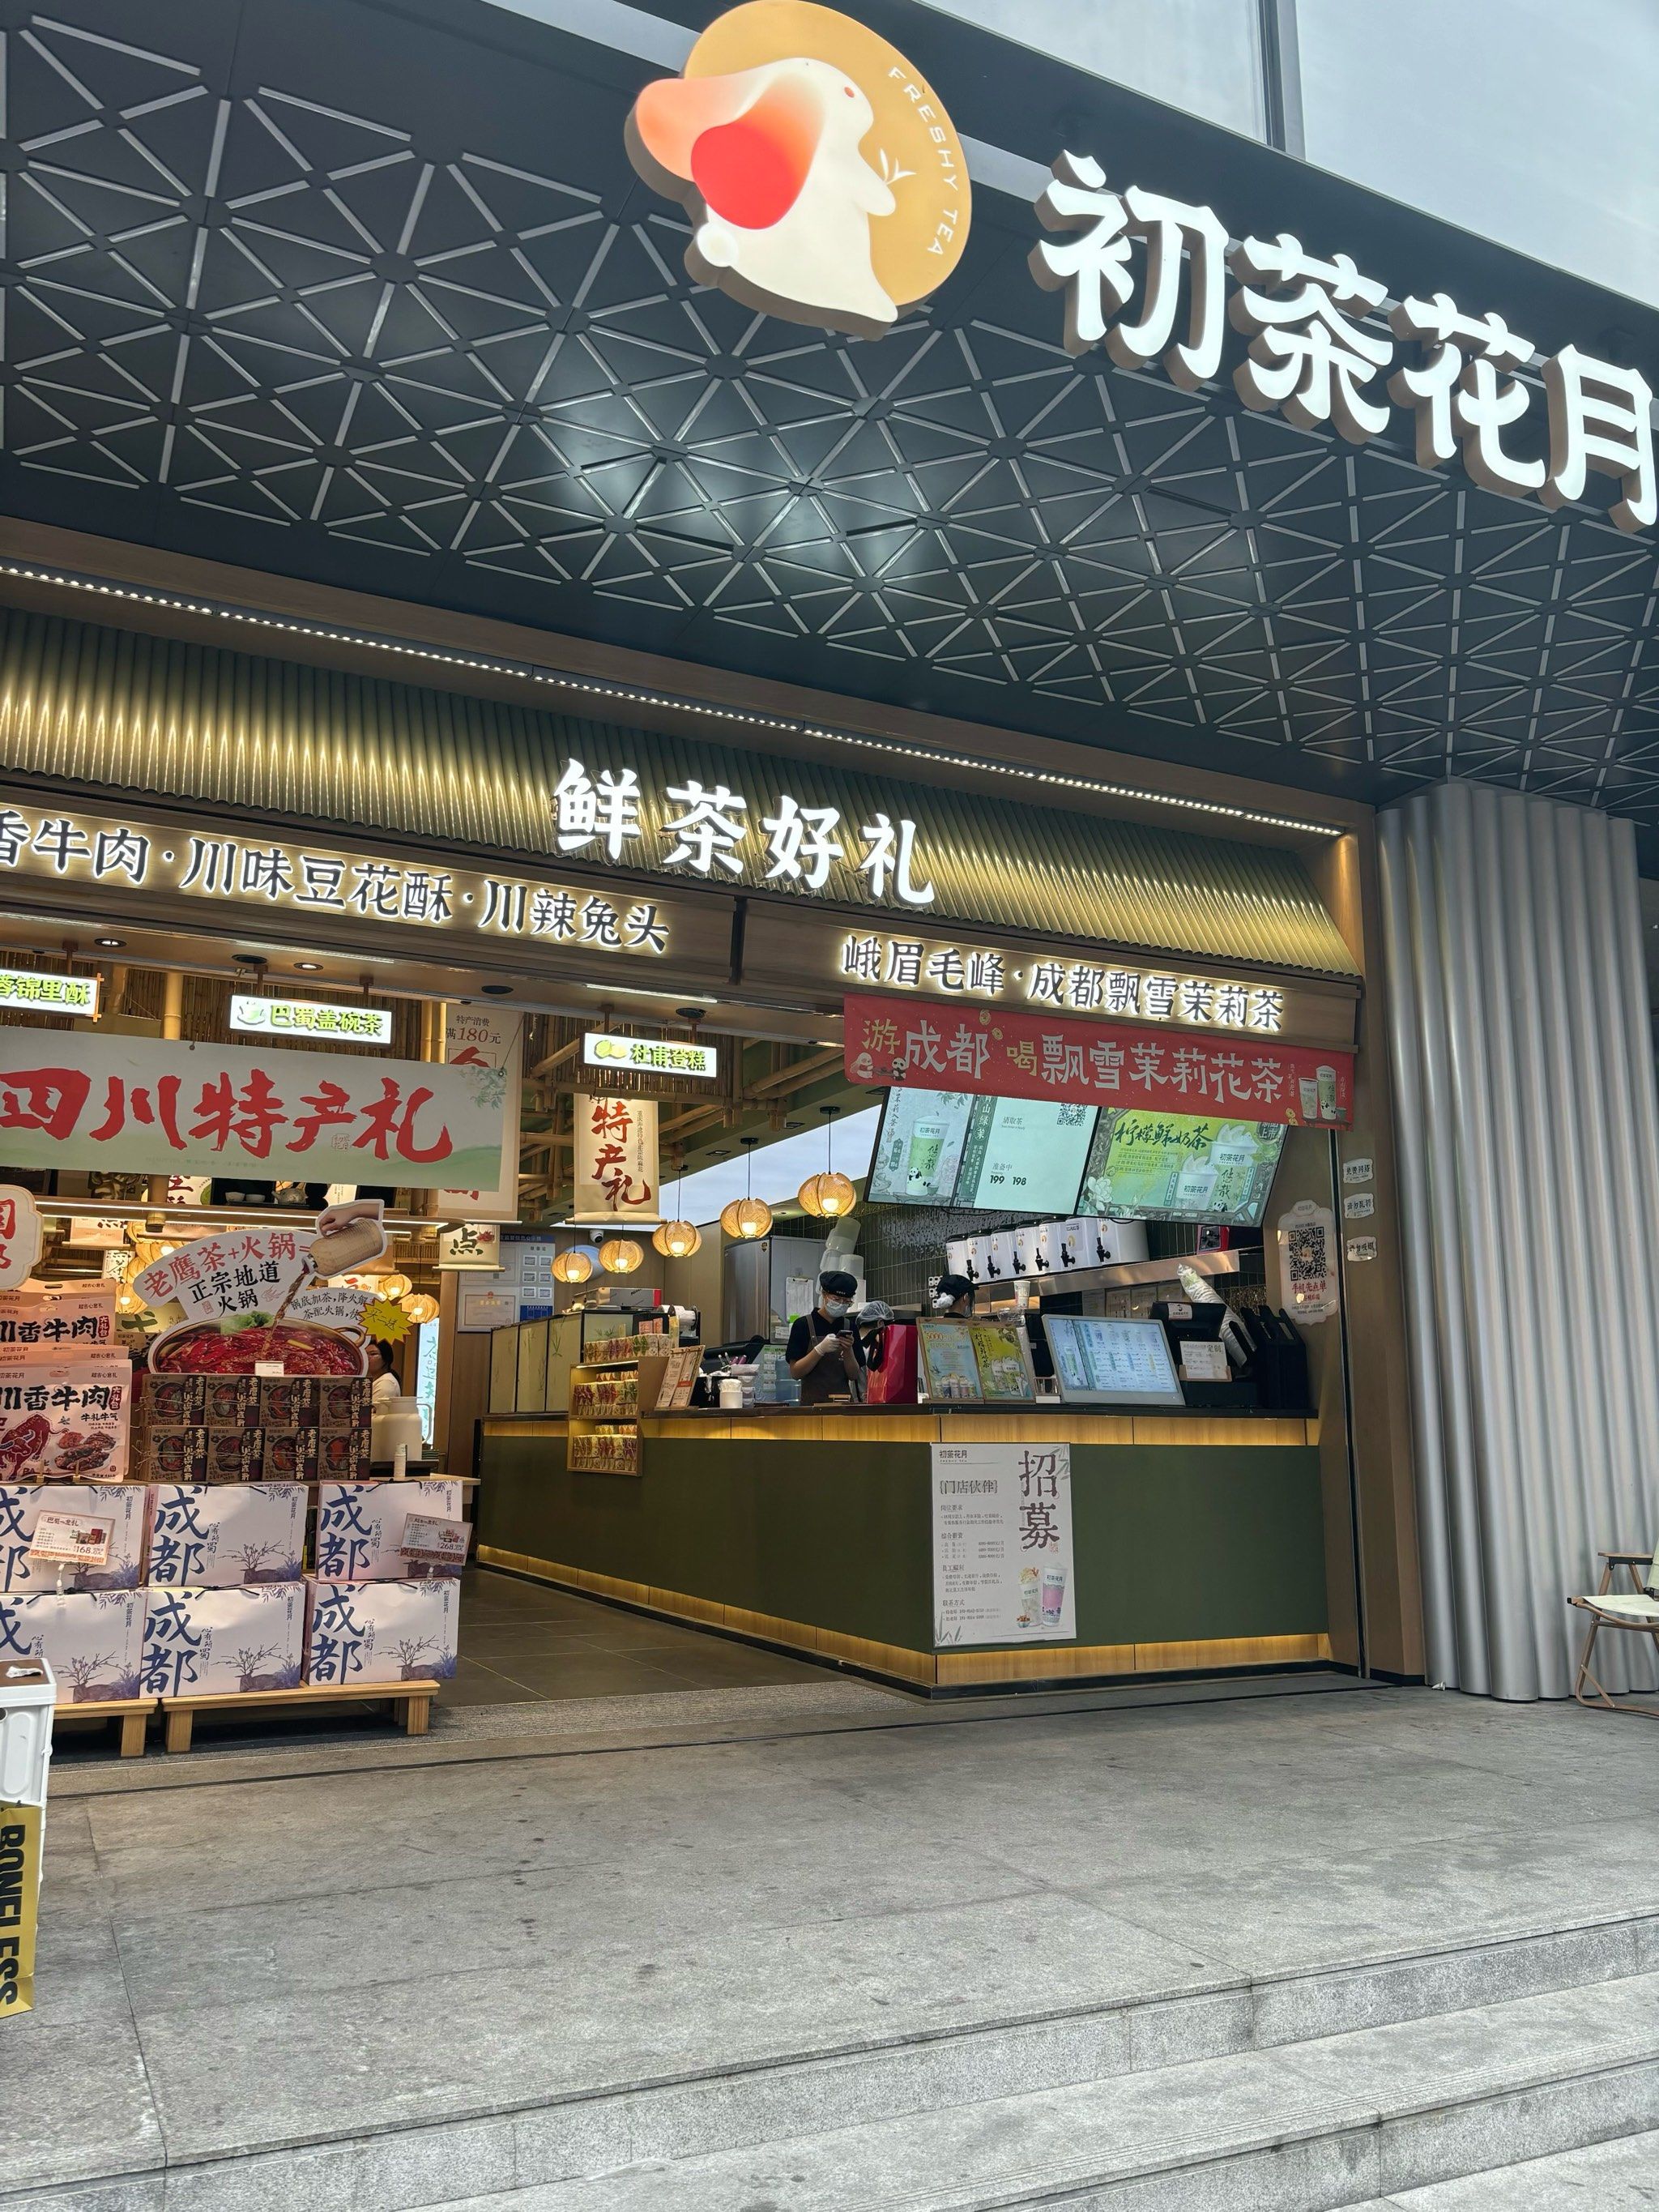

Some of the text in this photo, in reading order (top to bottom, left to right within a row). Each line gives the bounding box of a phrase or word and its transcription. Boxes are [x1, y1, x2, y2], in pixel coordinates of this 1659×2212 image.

[889, 66, 959, 256] FRESHY TEA
[1030, 149, 1659, 528] 初茶花月
[553, 758, 936, 904] 鲜茶好礼
[270, 1003, 383, 1037] 巴蜀盖碗茶
[446, 1027, 501, 1044] 满180元
[456, 1014, 490, 1027] 特产消费
[0, 1067, 454, 1164] 四川特产礼
[1114, 1118, 1215, 1150] 柠檬鲜奶茶
[591, 1100, 652, 1211] 特产礼
[1219, 1153, 1246, 1162] 初茶花月
[990, 1175, 1027, 1185] 199 198
[1183, 1185, 1208, 1194] 初茶花月
[188, 1260, 281, 1305] 正宗地道
[218, 1288, 259, 1317] 火锅
[0, 1316, 98, 1343] 川香牛肉
[0, 1385, 110, 1411] 川香牛肉
[940, 1450, 967, 1458] 初茶花月
[125, 1496, 133, 1520] 初茶花月
[290, 1497, 298, 1519] 初茶花月
[1018, 1450, 1060, 1550] 招募
[149, 1485, 209, 1586] 成都
[207, 1522, 221, 1554] 心有所蜀
[318, 1484, 372, 1580] 成都
[370, 1518, 382, 1549] 心有所蜀
[125, 1602, 134, 1628] 初茶花月
[286, 1596, 294, 1620] 初茶花月
[32, 1633, 45, 1659] 心有所
[139, 1591, 203, 1697] 成都
[199, 1626, 213, 1660] 心有所蜀
[309, 1584, 365, 1685] 成都
[364, 1618, 376, 1650] 心有所蜀
